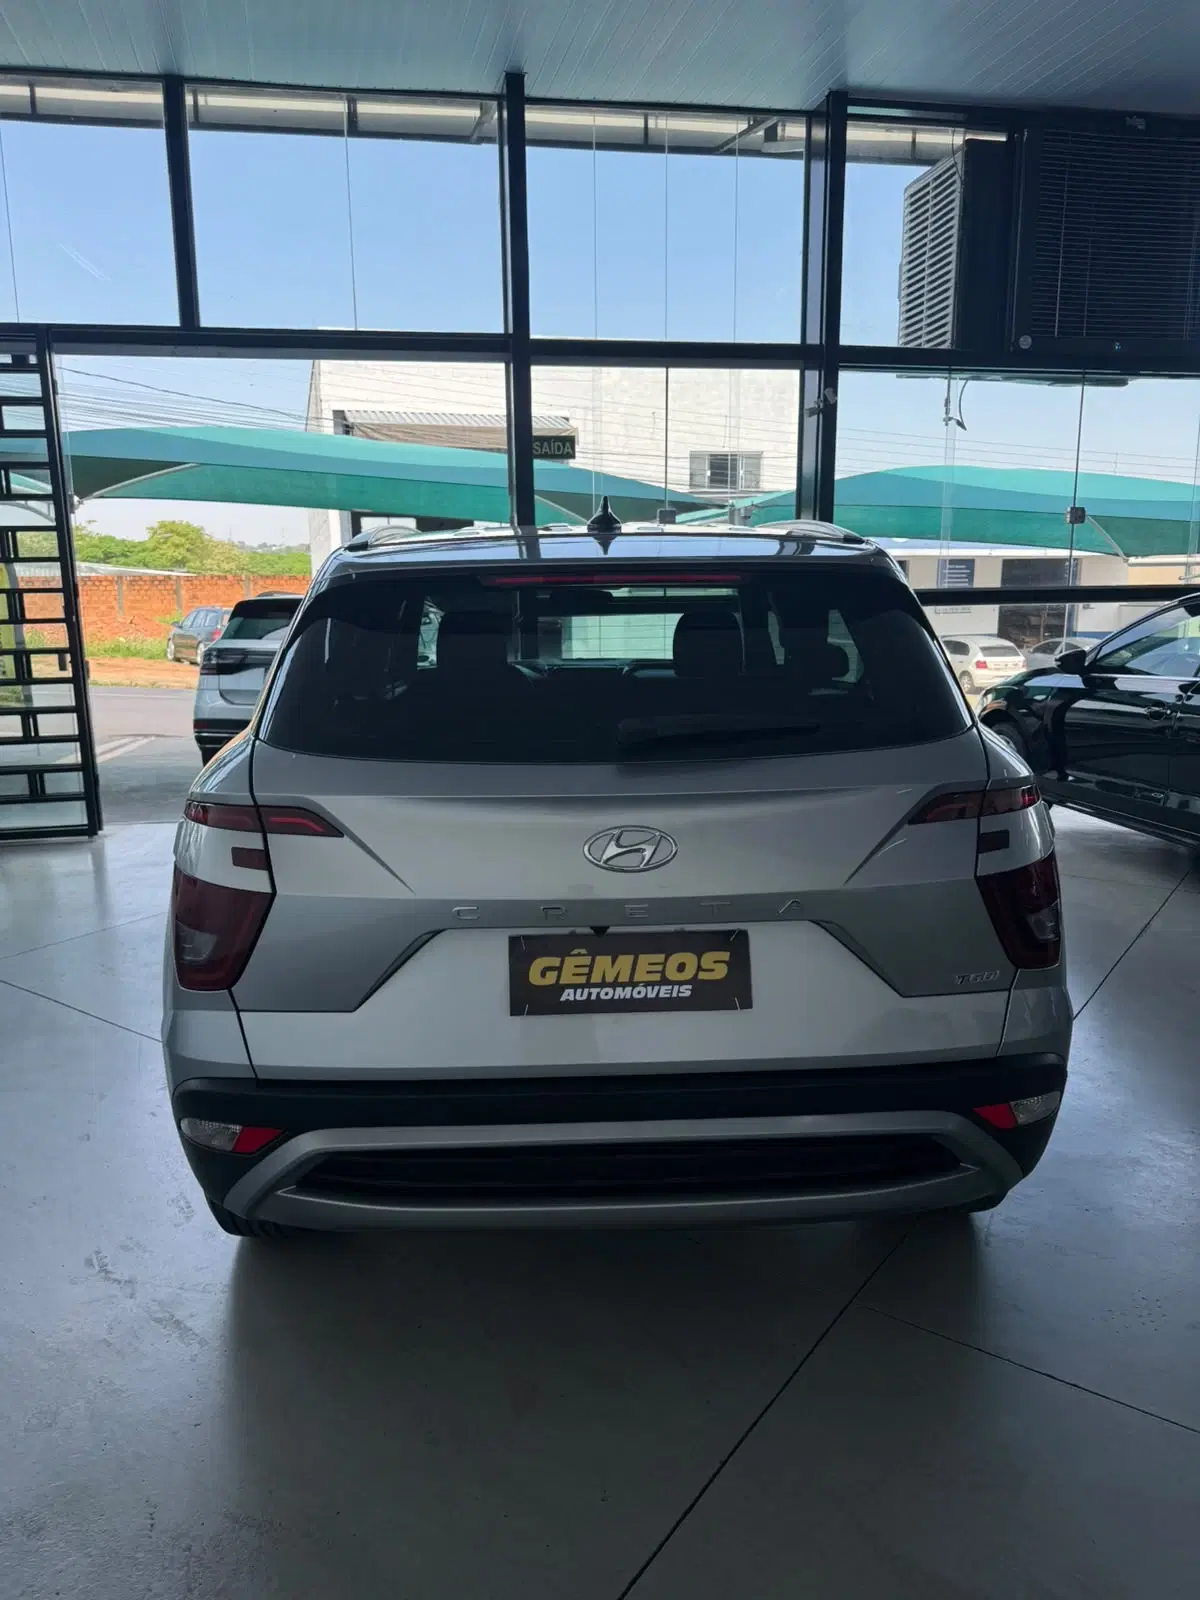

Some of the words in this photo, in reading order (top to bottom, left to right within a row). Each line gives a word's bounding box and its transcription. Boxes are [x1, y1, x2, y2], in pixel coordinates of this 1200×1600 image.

[532, 438, 572, 455] SAÍDA
[452, 899, 802, 920] CRETA
[528, 948, 731, 986] GÊMEOS
[560, 983, 692, 1002] AUTOMÓVEIS
